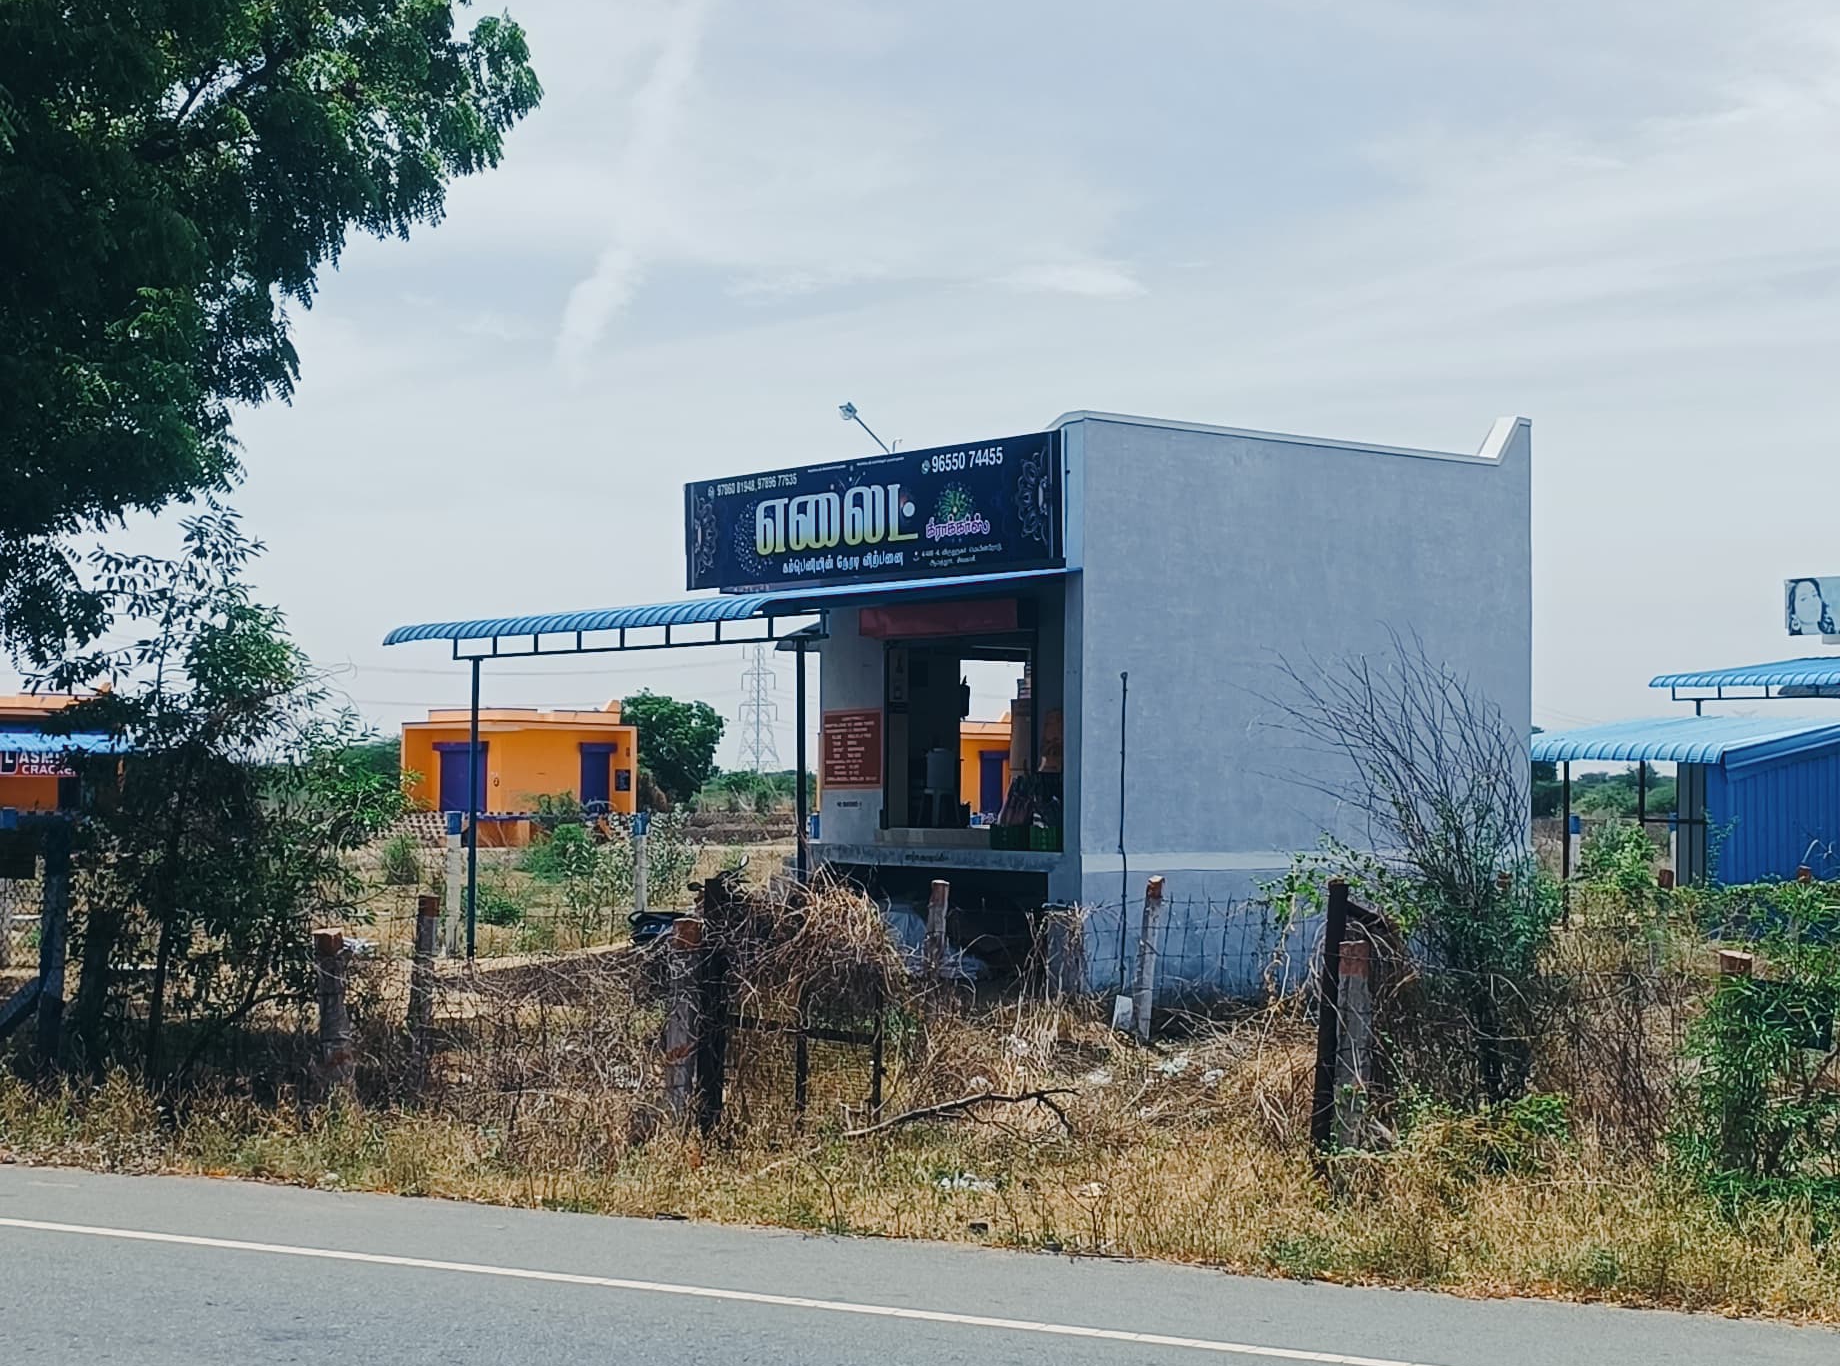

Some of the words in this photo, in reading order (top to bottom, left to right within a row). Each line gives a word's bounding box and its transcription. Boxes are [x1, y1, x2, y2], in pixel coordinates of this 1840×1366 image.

[932, 452, 966, 473] 96550
[968, 446, 1004, 468] 74455
[755, 483, 919, 556] எலைட்
[862, 549, 904, 569] விற்பனை
[21, 764, 76, 776] CRACE
